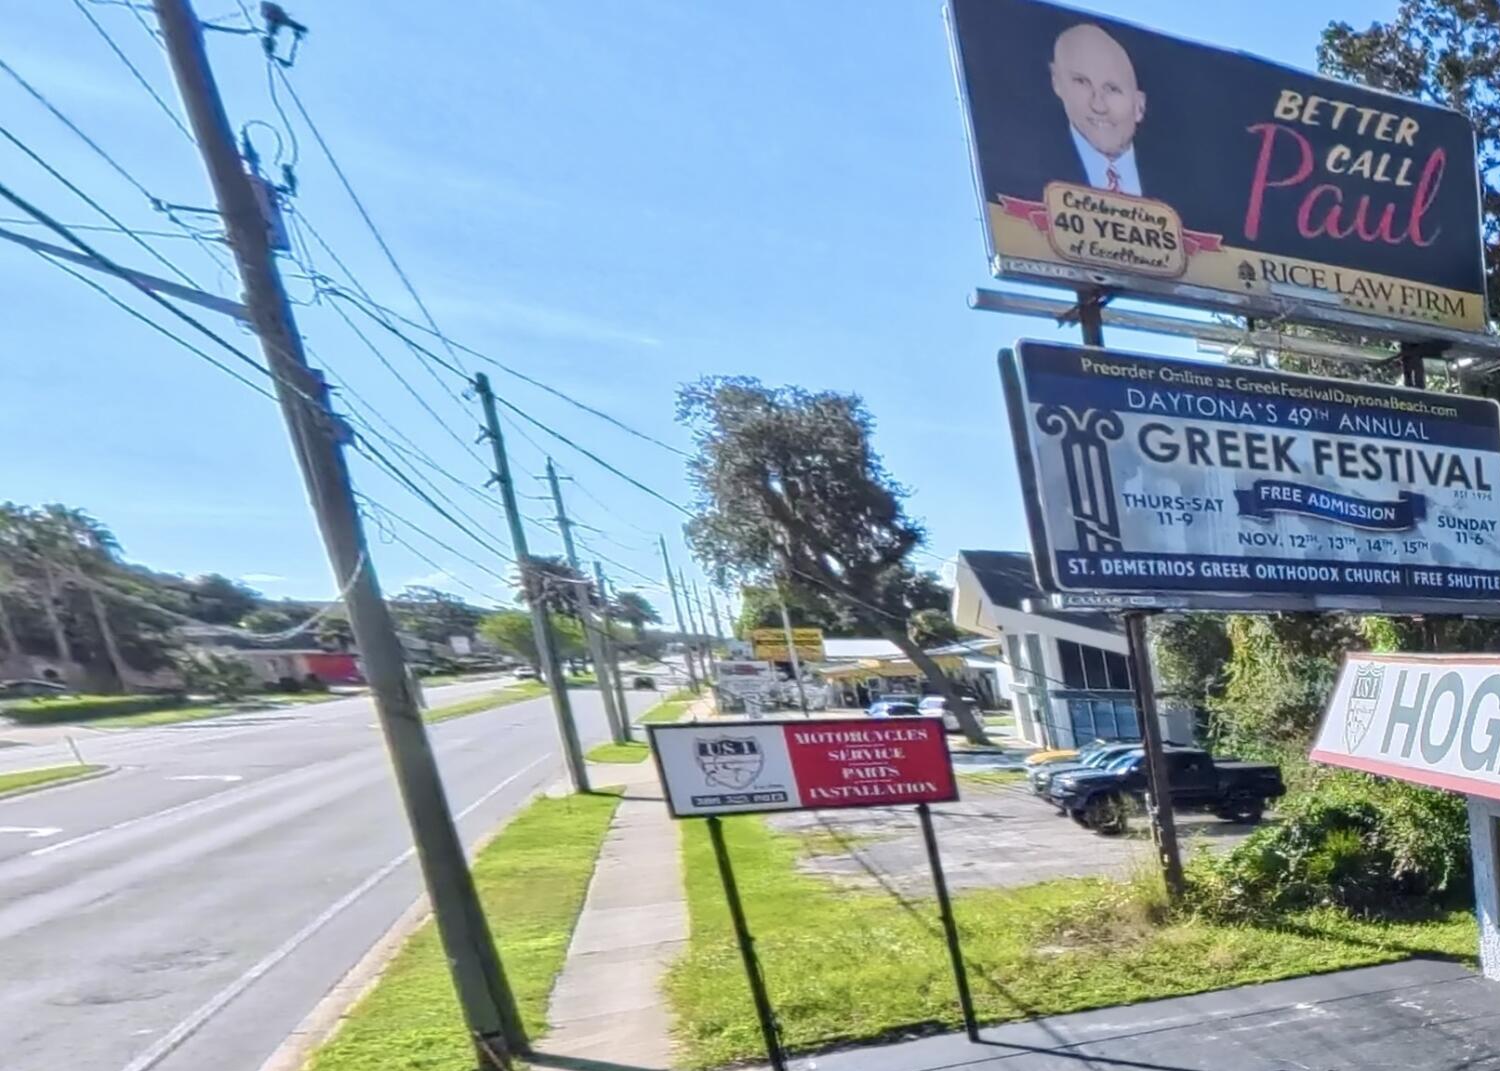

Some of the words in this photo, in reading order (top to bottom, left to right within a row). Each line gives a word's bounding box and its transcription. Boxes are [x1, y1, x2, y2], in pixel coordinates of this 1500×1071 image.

[1274, 89, 1420, 147] BETTER
[1325, 143, 1413, 186] CALL
[1244, 122, 1447, 247] Paul
[1062, 191, 1168, 230] Celebrating
[1054, 212, 1084, 234] 40
[1094, 218, 1177, 251] YEARS
[1070, 239, 1083, 255] of
[1089, 243, 1169, 268] Excellence!
[1259, 258, 1329, 291] RICE
[1334, 272, 1396, 301] LAW
[1401, 286, 1467, 318] FIRM
[1080, 357, 1154, 380] Preorder
[1159, 367, 1213, 388] Online
[1217, 376, 1232, 389] at
[1236, 377, 1458, 418] GreekFestivalDaytonaBeach.com
[1127, 388, 1278, 423] DAYTONA'S
[1287, 407, 1329, 427] 49TH
[1338, 413, 1430, 441] ANNUAL
[1138, 422, 1302, 475] GREEK
[1312, 438, 1492, 492] FESTIVAL
[1122, 493, 1225, 513] THURS-SAT
[1260, 486, 1302, 503] FREE
[1307, 493, 1396, 521] ADMISSION
[1157, 512, 1193, 526] 11-9
[1437, 516, 1498, 532] SUNDAY
[1238, 532, 1284, 548] NOV.
[1402, 540, 1429, 554] 15TH
[1455, 531, 1485, 546] 11-6
[1068, 558, 1096, 575] ST.
[1101, 559, 1195, 577] DEMETRIOS
[1200, 562, 1251, 578] GREEK
[1255, 564, 1340, 582] ORTHODOX
[1345, 567, 1400, 584] CHURCH
[1413, 571, 1443, 586] FREE
[1447, 573, 1500, 590] SHUTTLE
[706, 743, 736, 755] US
[794, 729, 929, 745] MOTORCYCLES
[827, 747, 906, 761] SERVICE
[841, 766, 901, 780] PARTS
[809, 782, 939, 799] INSTALLATION
